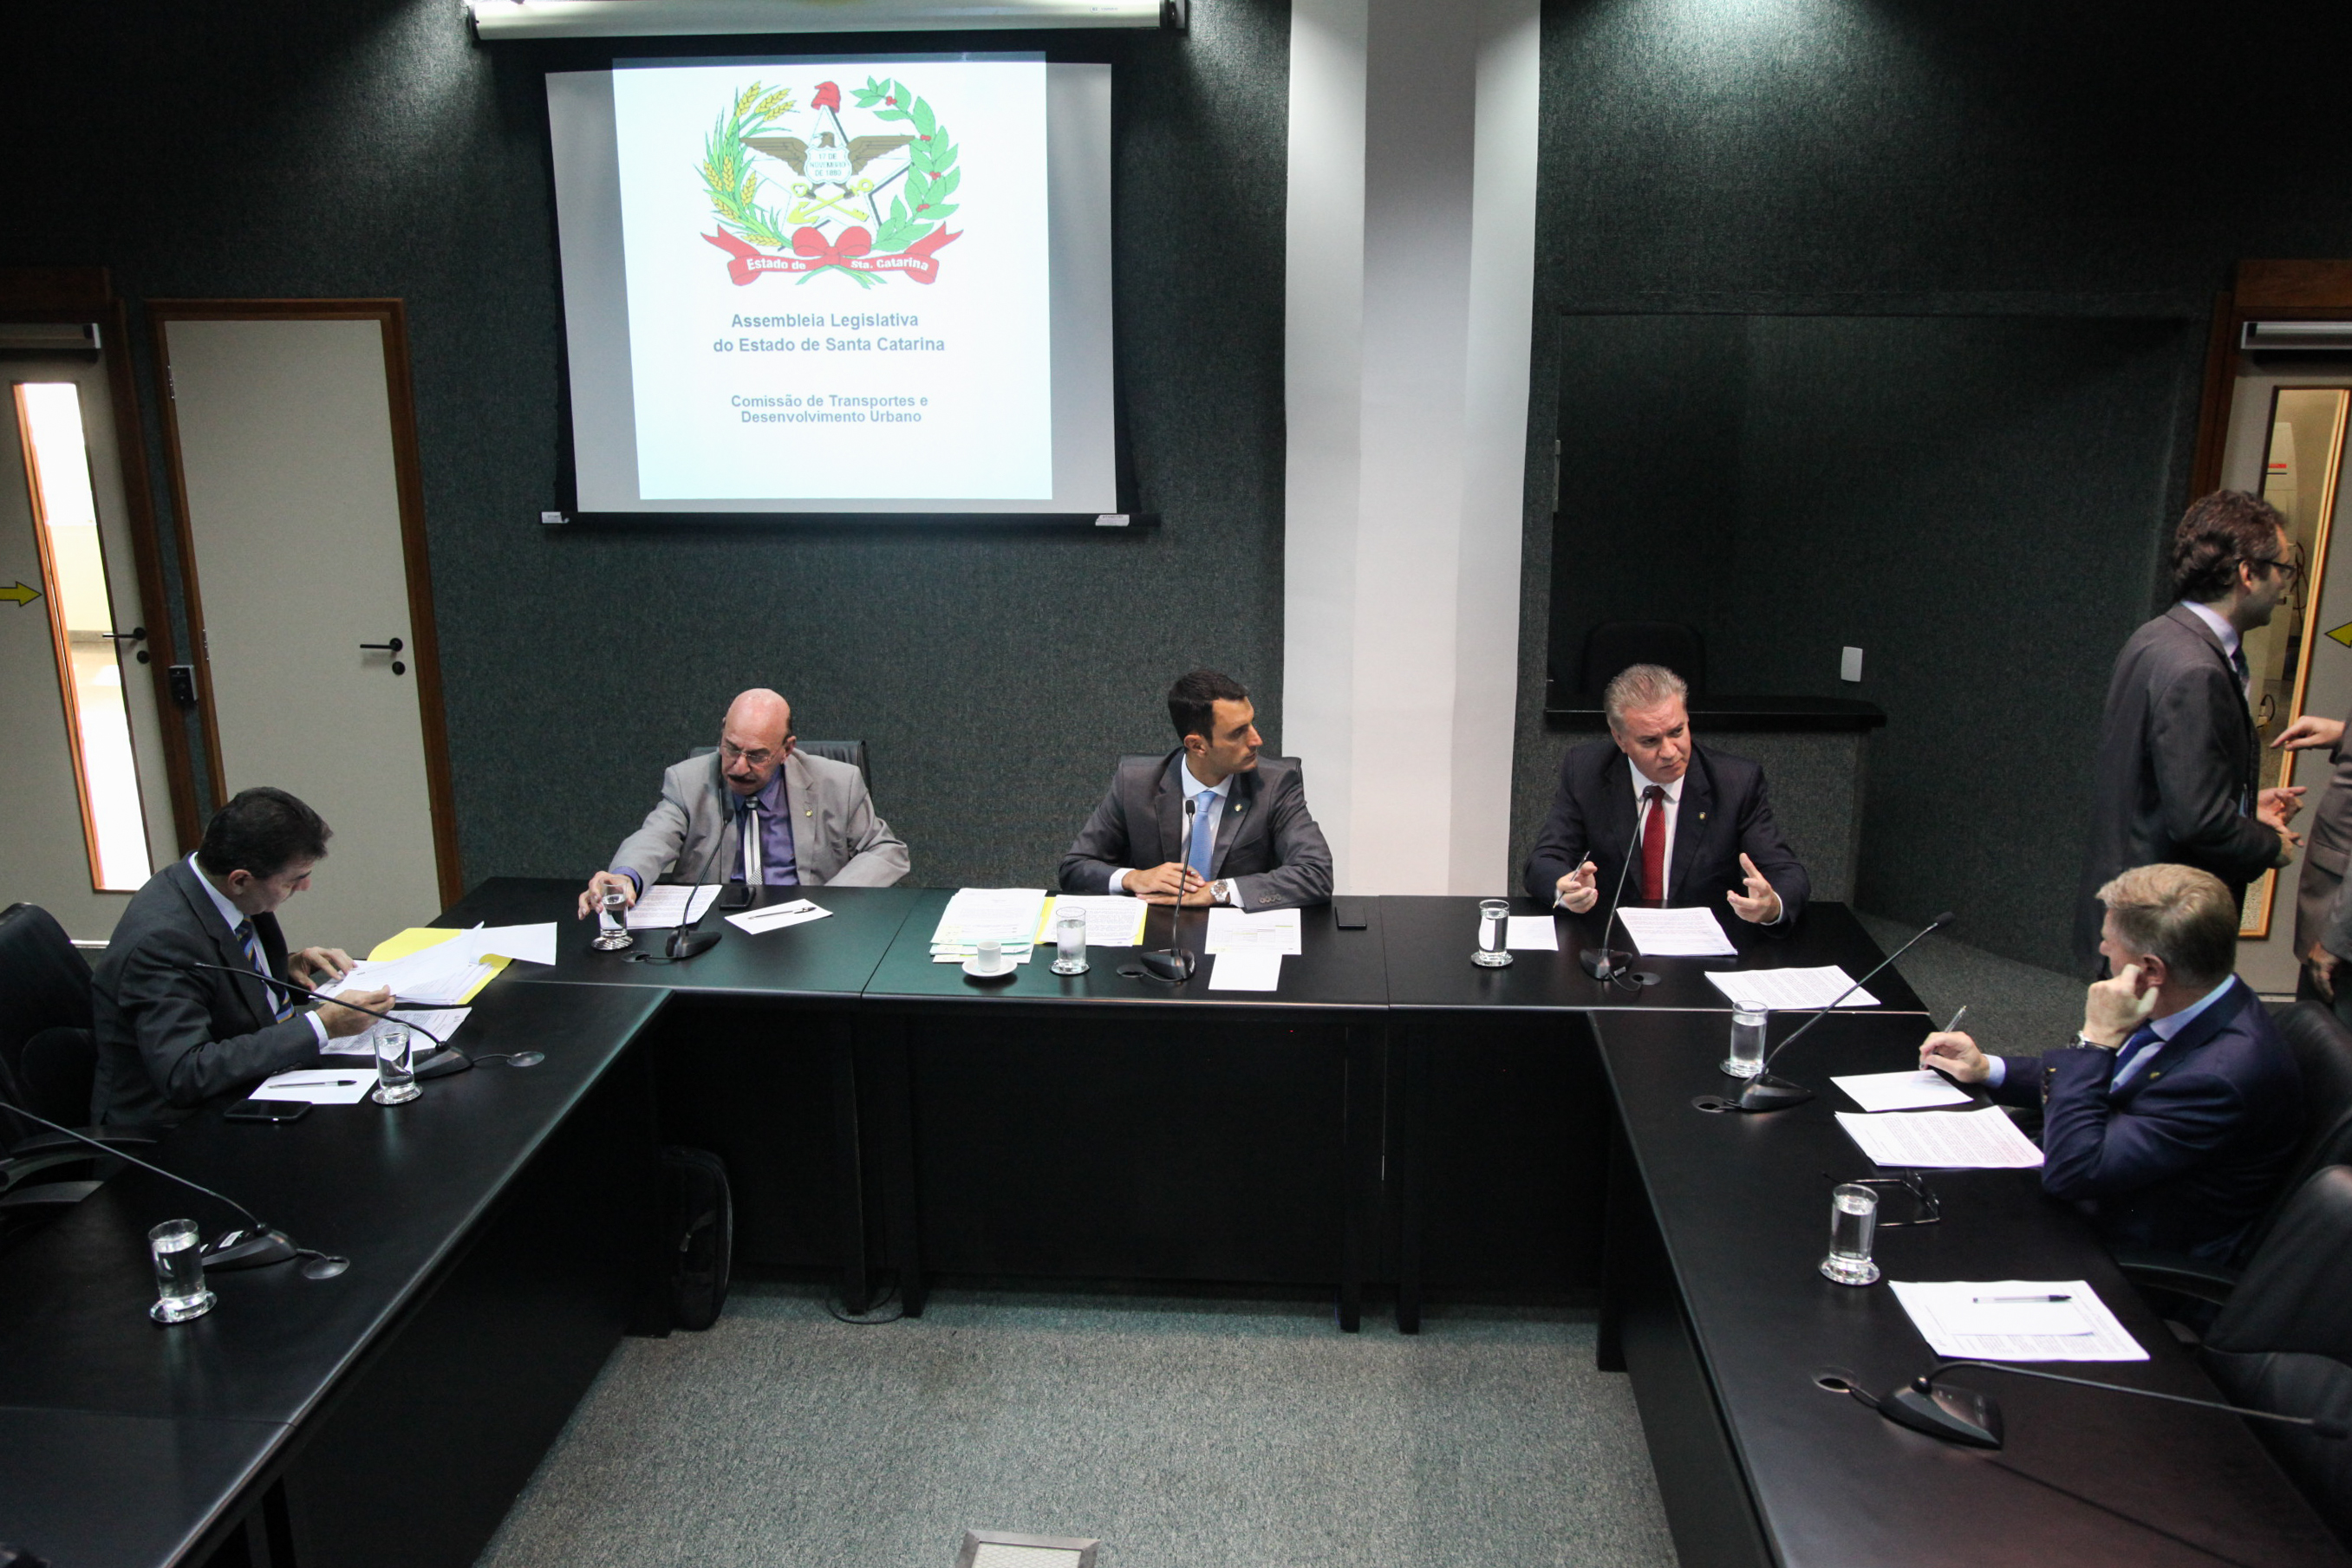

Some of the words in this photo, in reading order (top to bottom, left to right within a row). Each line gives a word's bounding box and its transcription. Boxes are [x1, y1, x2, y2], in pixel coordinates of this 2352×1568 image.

[746, 258, 788, 270] Estado
[792, 260, 806, 270] de
[850, 260, 873, 270] Sta.
[876, 257, 928, 270] Catarina
[732, 313, 824, 328] Assembleia
[831, 313, 919, 330] Legislativa
[713, 339, 733, 352] do
[739, 338, 795, 351] Estado
[801, 338, 820, 351] de
[825, 337, 871, 351] Santa
[876, 337, 945, 351] Catarina
[731, 394, 802, 407] Comissão
[806, 394, 824, 407] de
[829, 394, 915, 410] Transportes
[920, 397, 928, 406] e
[741, 410, 865, 423] Desenvolvimento
[870, 410, 922, 423] Urbano
